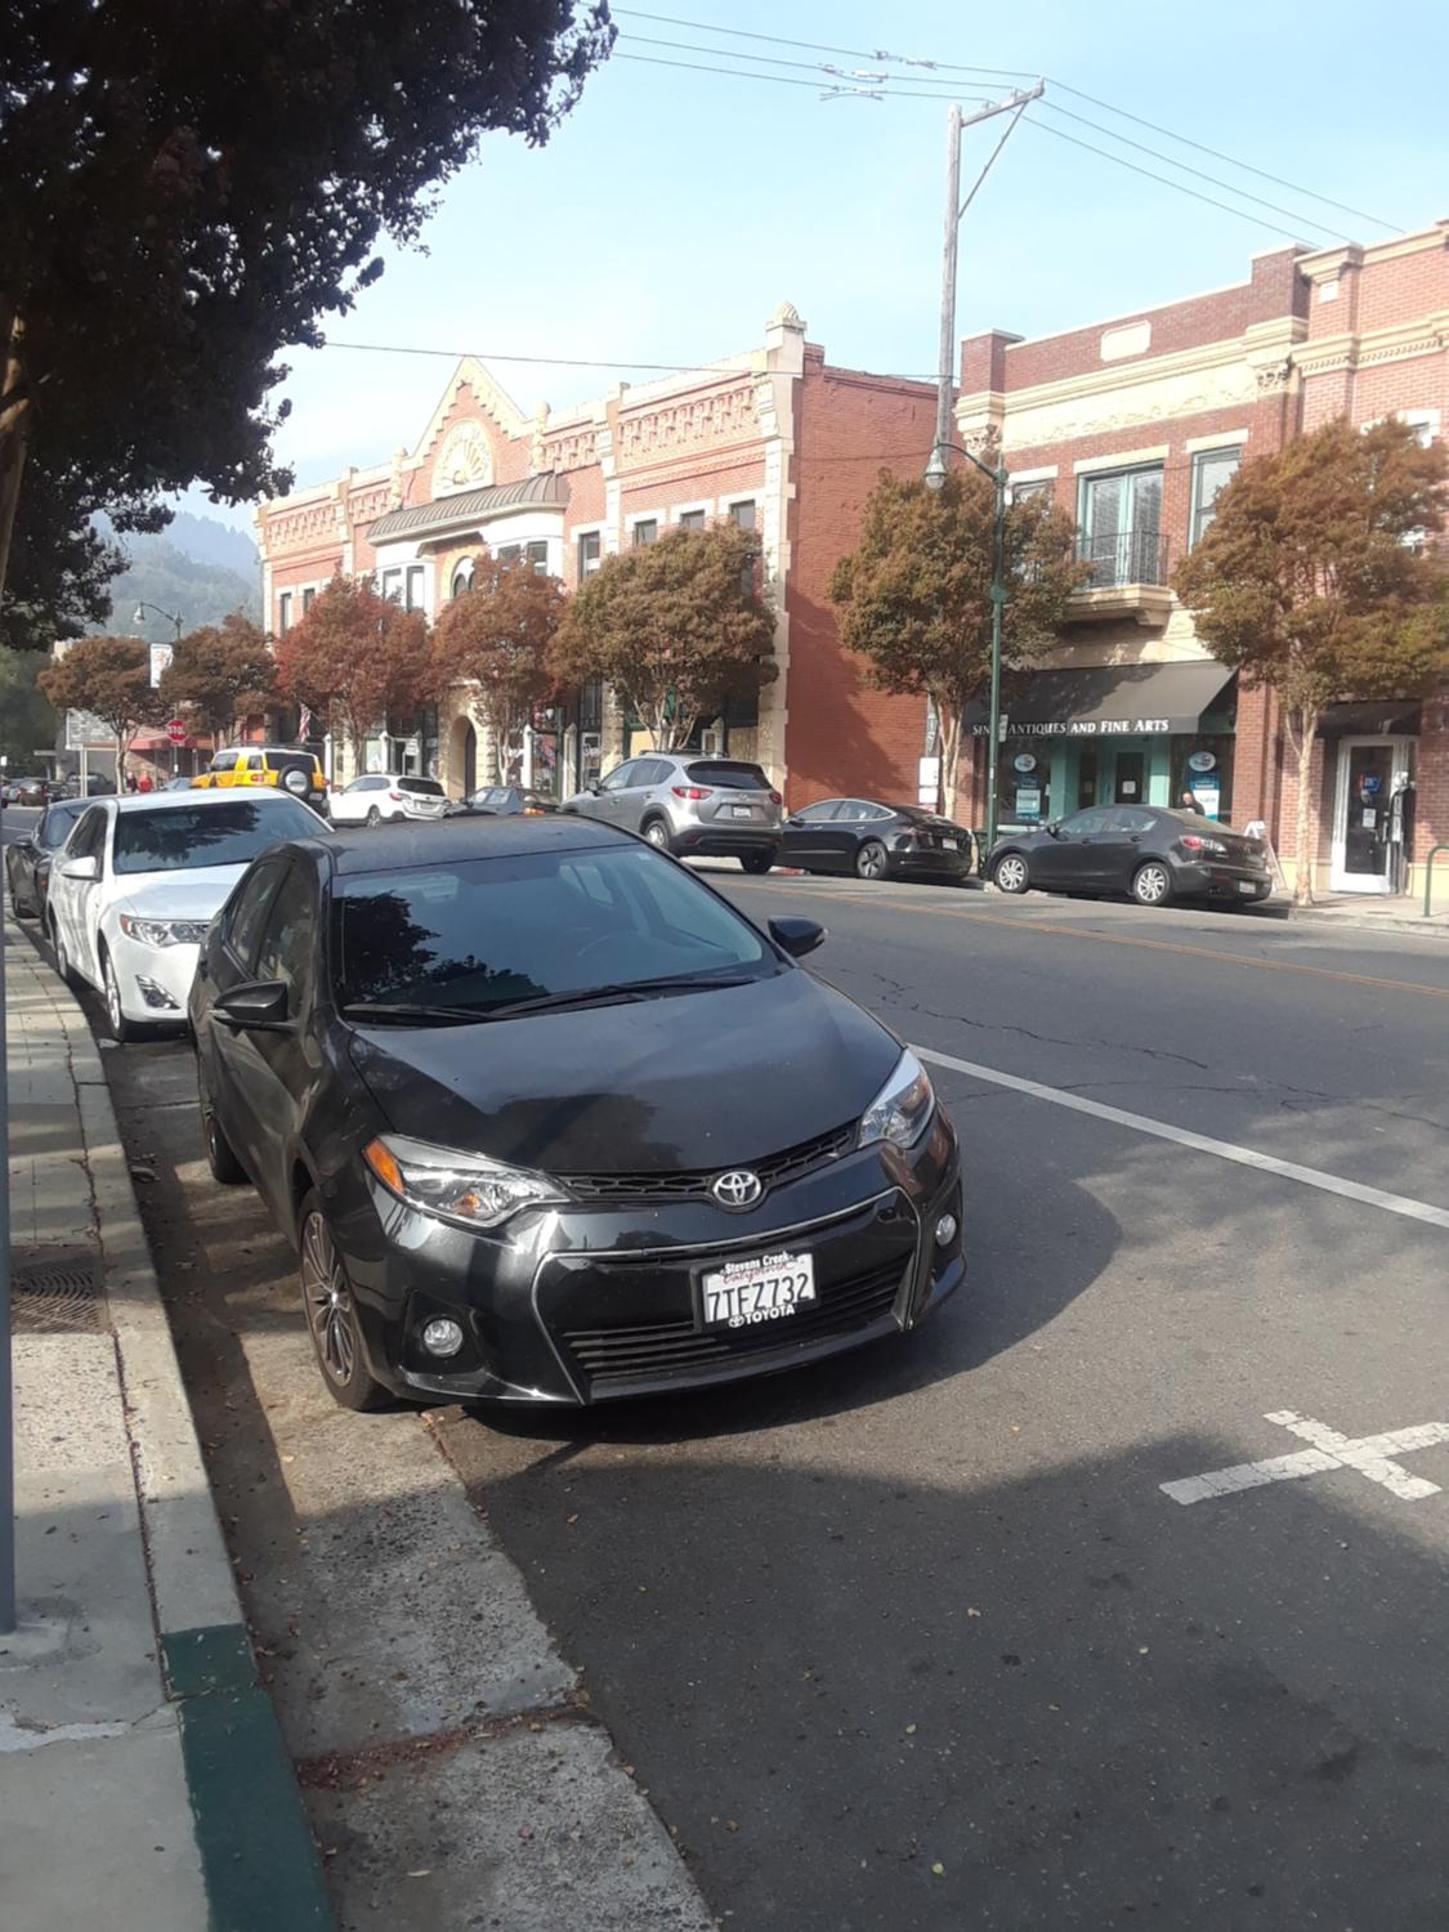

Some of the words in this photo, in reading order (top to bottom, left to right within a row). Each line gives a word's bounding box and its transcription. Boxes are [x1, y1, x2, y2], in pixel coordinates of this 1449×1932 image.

[1007, 721, 1067, 736] ANTIQUES
[1070, 721, 1096, 733] AND
[1100, 719, 1130, 733] FINE
[1134, 718, 1170, 732] ARTS
[707, 1272, 810, 1322] 7TFZ732
[745, 1303, 796, 1325] TOYOTA
